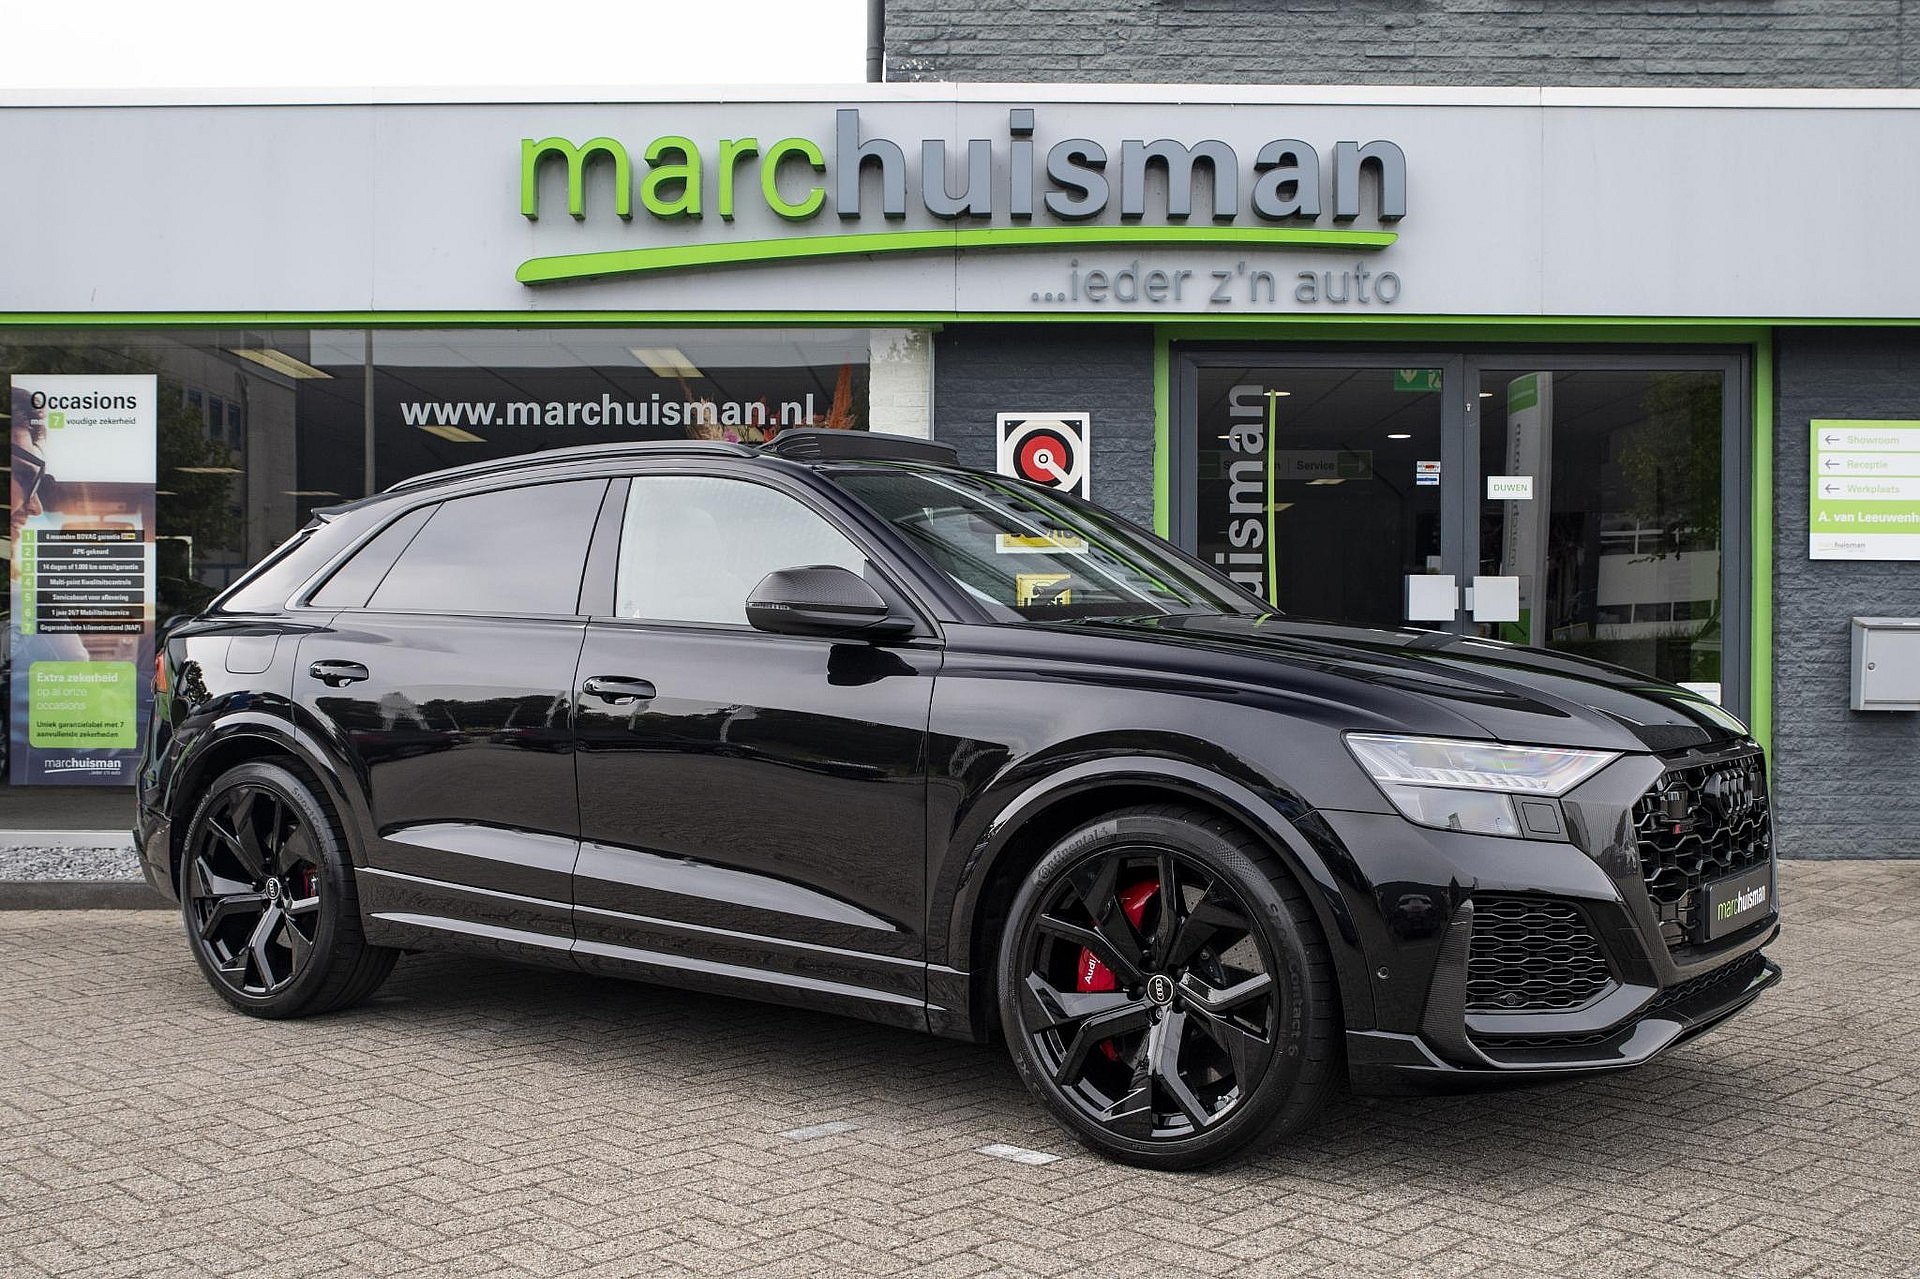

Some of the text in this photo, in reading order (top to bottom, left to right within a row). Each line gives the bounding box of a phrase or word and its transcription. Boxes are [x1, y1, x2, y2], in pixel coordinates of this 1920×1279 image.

[520, 109, 1406, 221] marchuisman
[1211, 260, 1275, 303] z'n
[1296, 260, 1401, 304] auto
[31, 391, 137, 409] Occasions
[400, 393, 815, 425] www.marchuisman.nl
[66, 417, 97, 426] voudige
[99, 416, 136, 425] zekerheid
[1847, 435, 1900, 445] Showroom
[1296, 460, 1335, 470] Service
[1847, 459, 1888, 470] Receptie
[1493, 483, 1528, 493] DUWEN
[1847, 483, 1900, 494] Werkplaats
[1818, 511, 1831, 522] A.
[1833, 513, 1855, 522] van
[37, 672, 118, 682] Extra zekerheid
[37, 688, 50, 698] op
[44, 757, 121, 768] marchuisman
[1717, 885, 1766, 920] marchuisman
[1084, 957, 1097, 985] Audi
